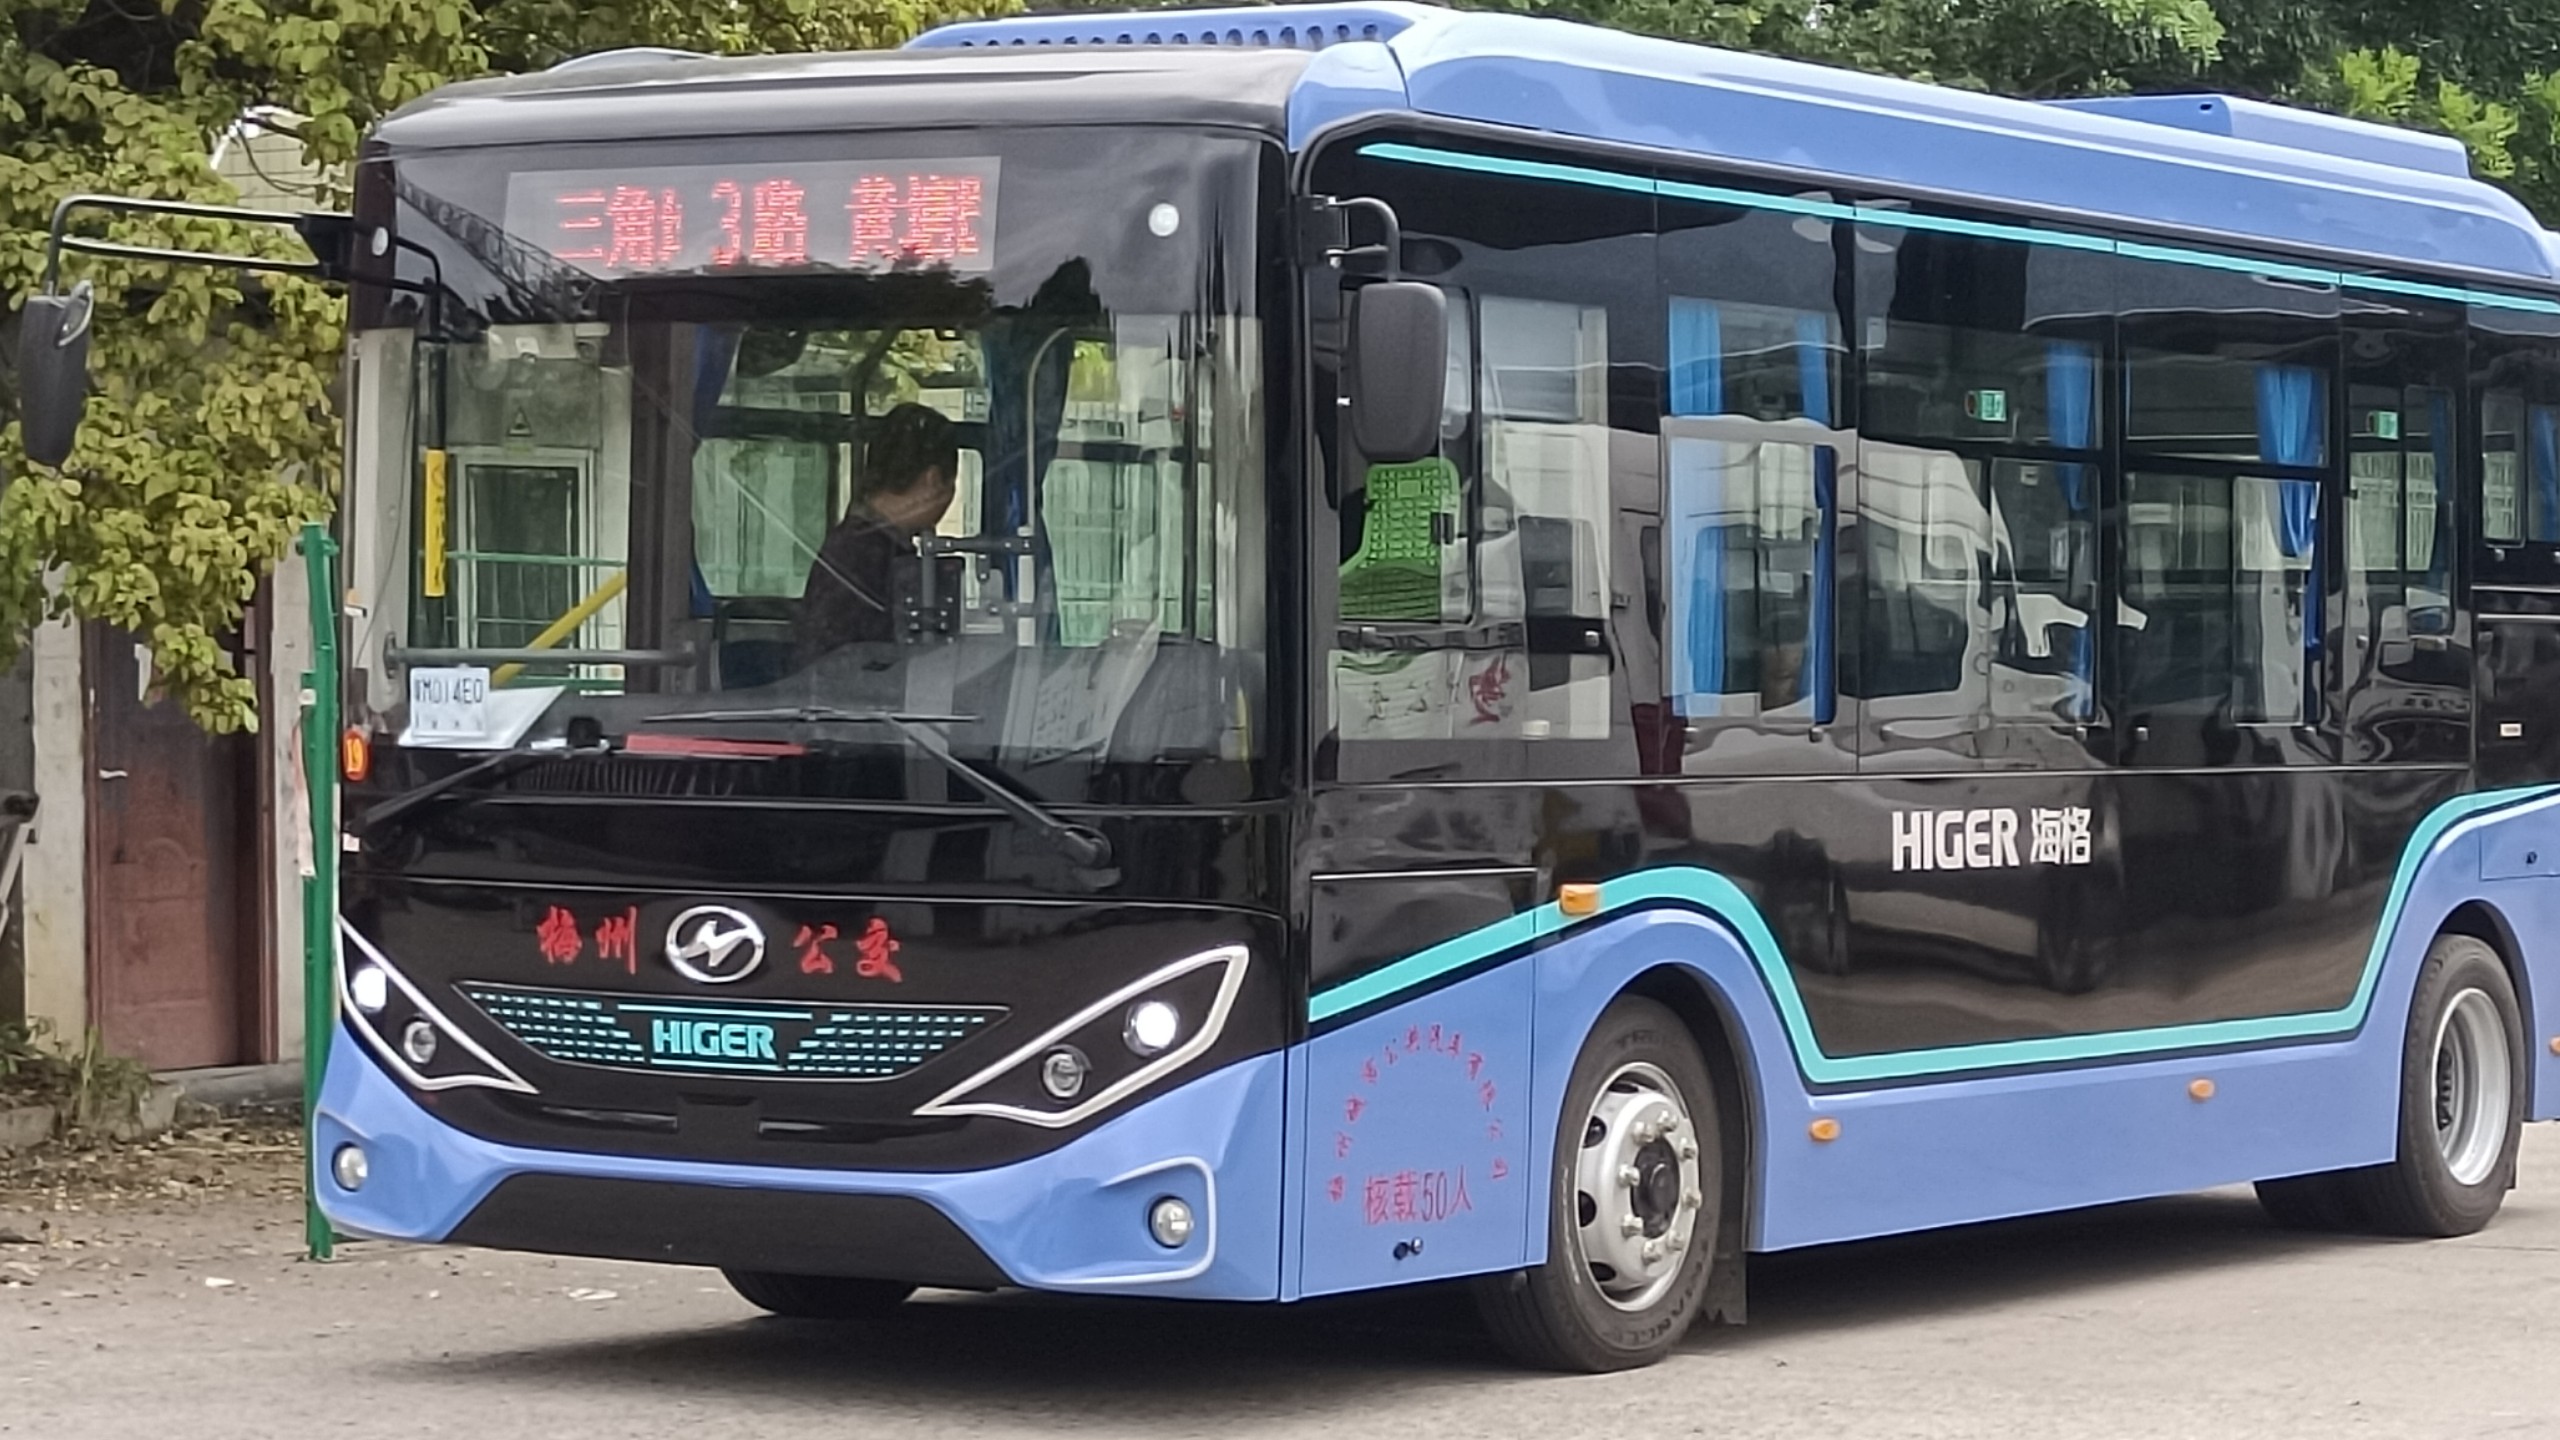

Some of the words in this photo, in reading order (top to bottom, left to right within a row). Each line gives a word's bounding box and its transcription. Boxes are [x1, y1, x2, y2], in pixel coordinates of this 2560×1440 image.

[1892, 807, 2020, 871] HIGER
[2030, 806, 2091, 864] 海格
[535, 905, 637, 974] 梅州
[793, 917, 902, 982] 公交
[651, 1018, 778, 1060] HIGER
[1365, 1164, 1472, 1225] 核载50人
